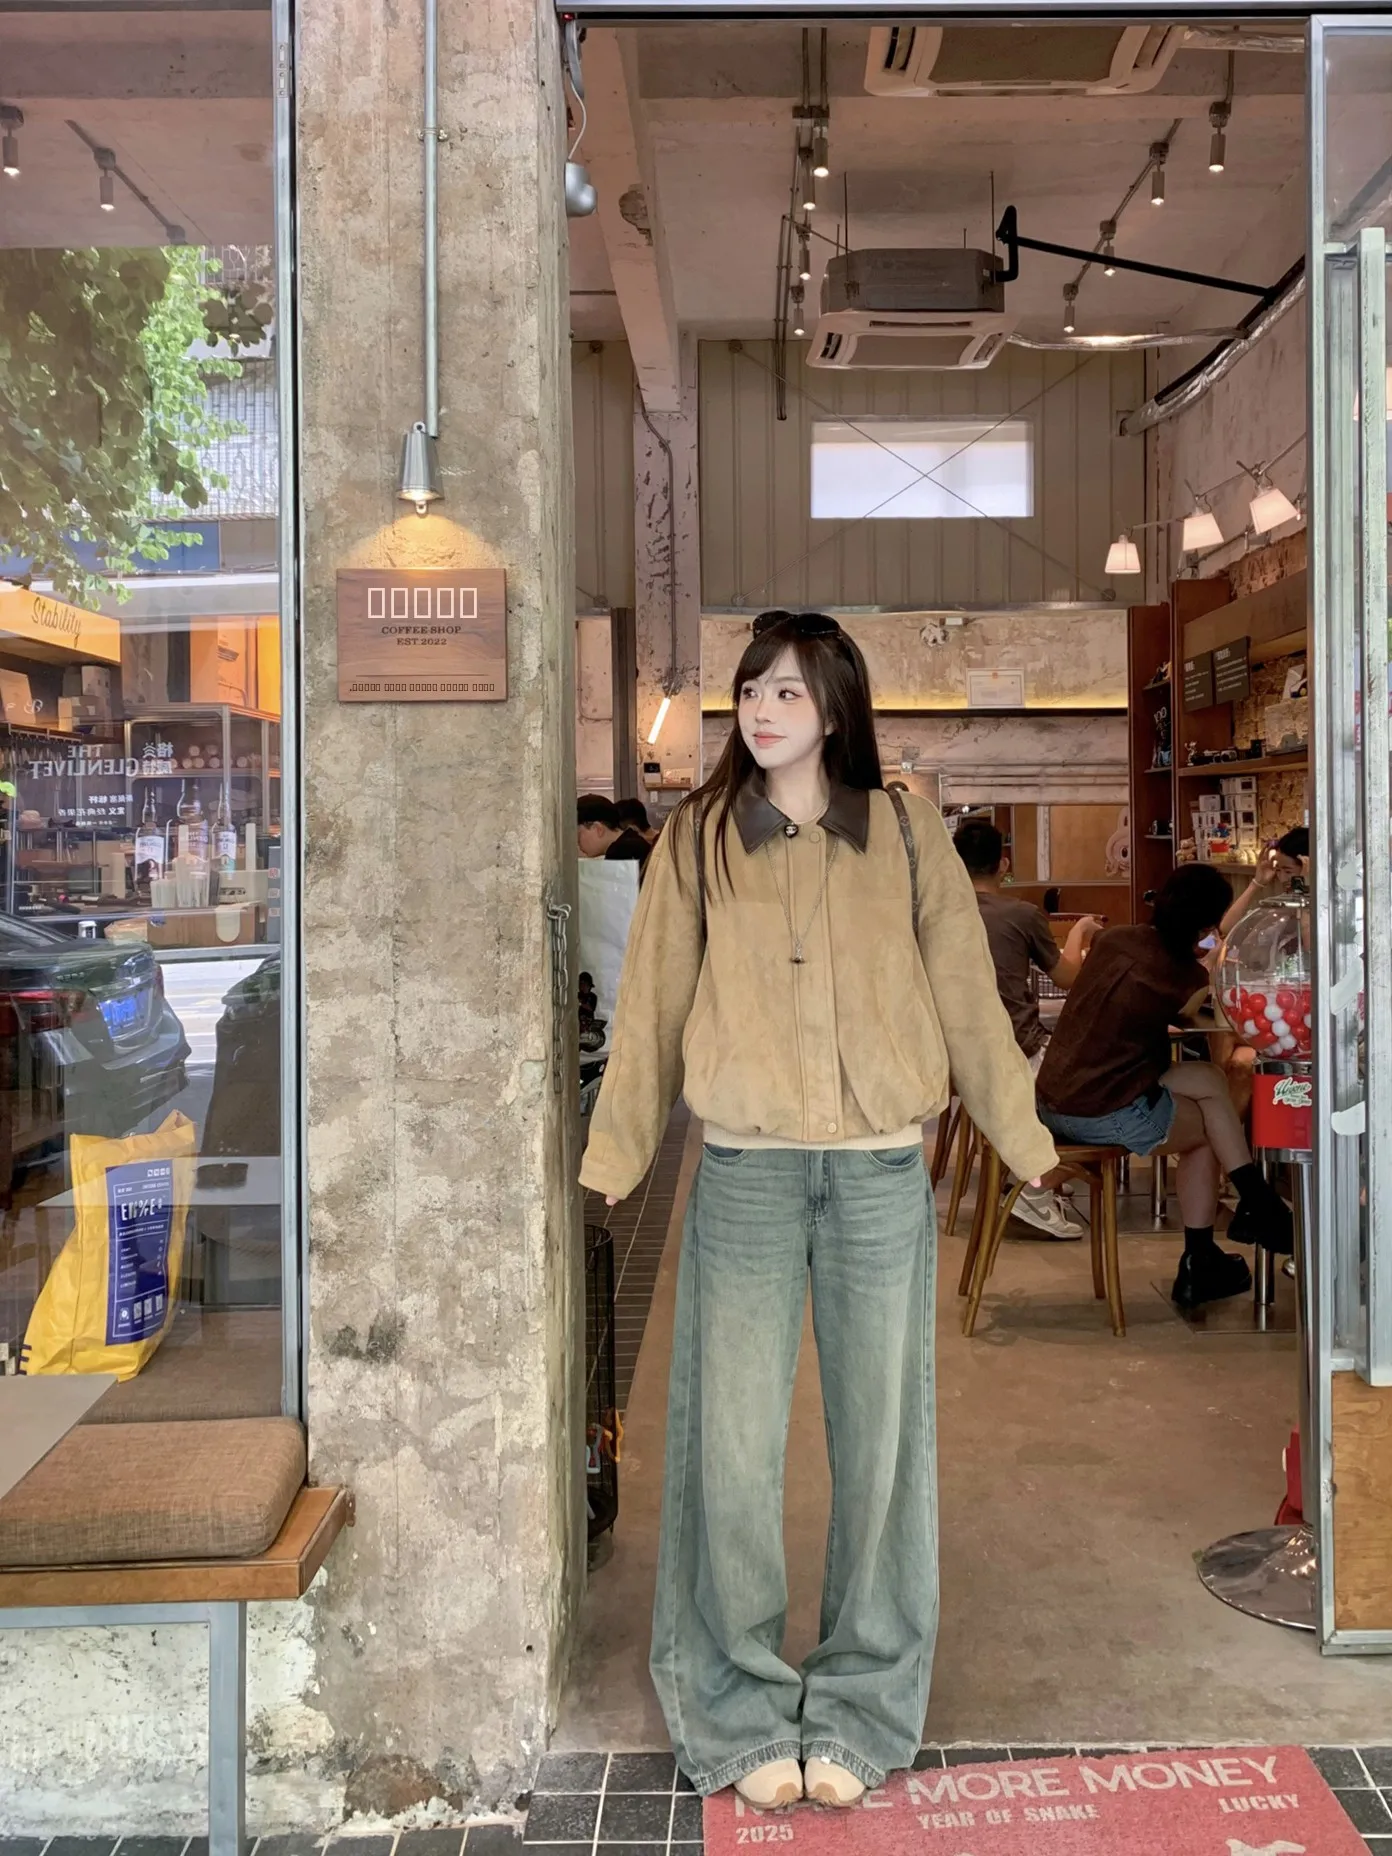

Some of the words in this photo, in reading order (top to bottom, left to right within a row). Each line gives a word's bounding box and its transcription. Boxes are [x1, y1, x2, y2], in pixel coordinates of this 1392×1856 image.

[31, 596, 81, 648] Stability
[381, 626, 428, 635] COFFEE
[430, 625, 461, 635] SHOP
[906, 1767, 1070, 1805] MORE
[1079, 1756, 1277, 1793] MONEY
[1218, 1794, 1300, 1813] LUCKY
[918, 1810, 975, 1829] YEAR
[985, 1808, 1013, 1825] OF
[1024, 1804, 1100, 1822] SNAKE
[735, 1824, 794, 1845] 2025
